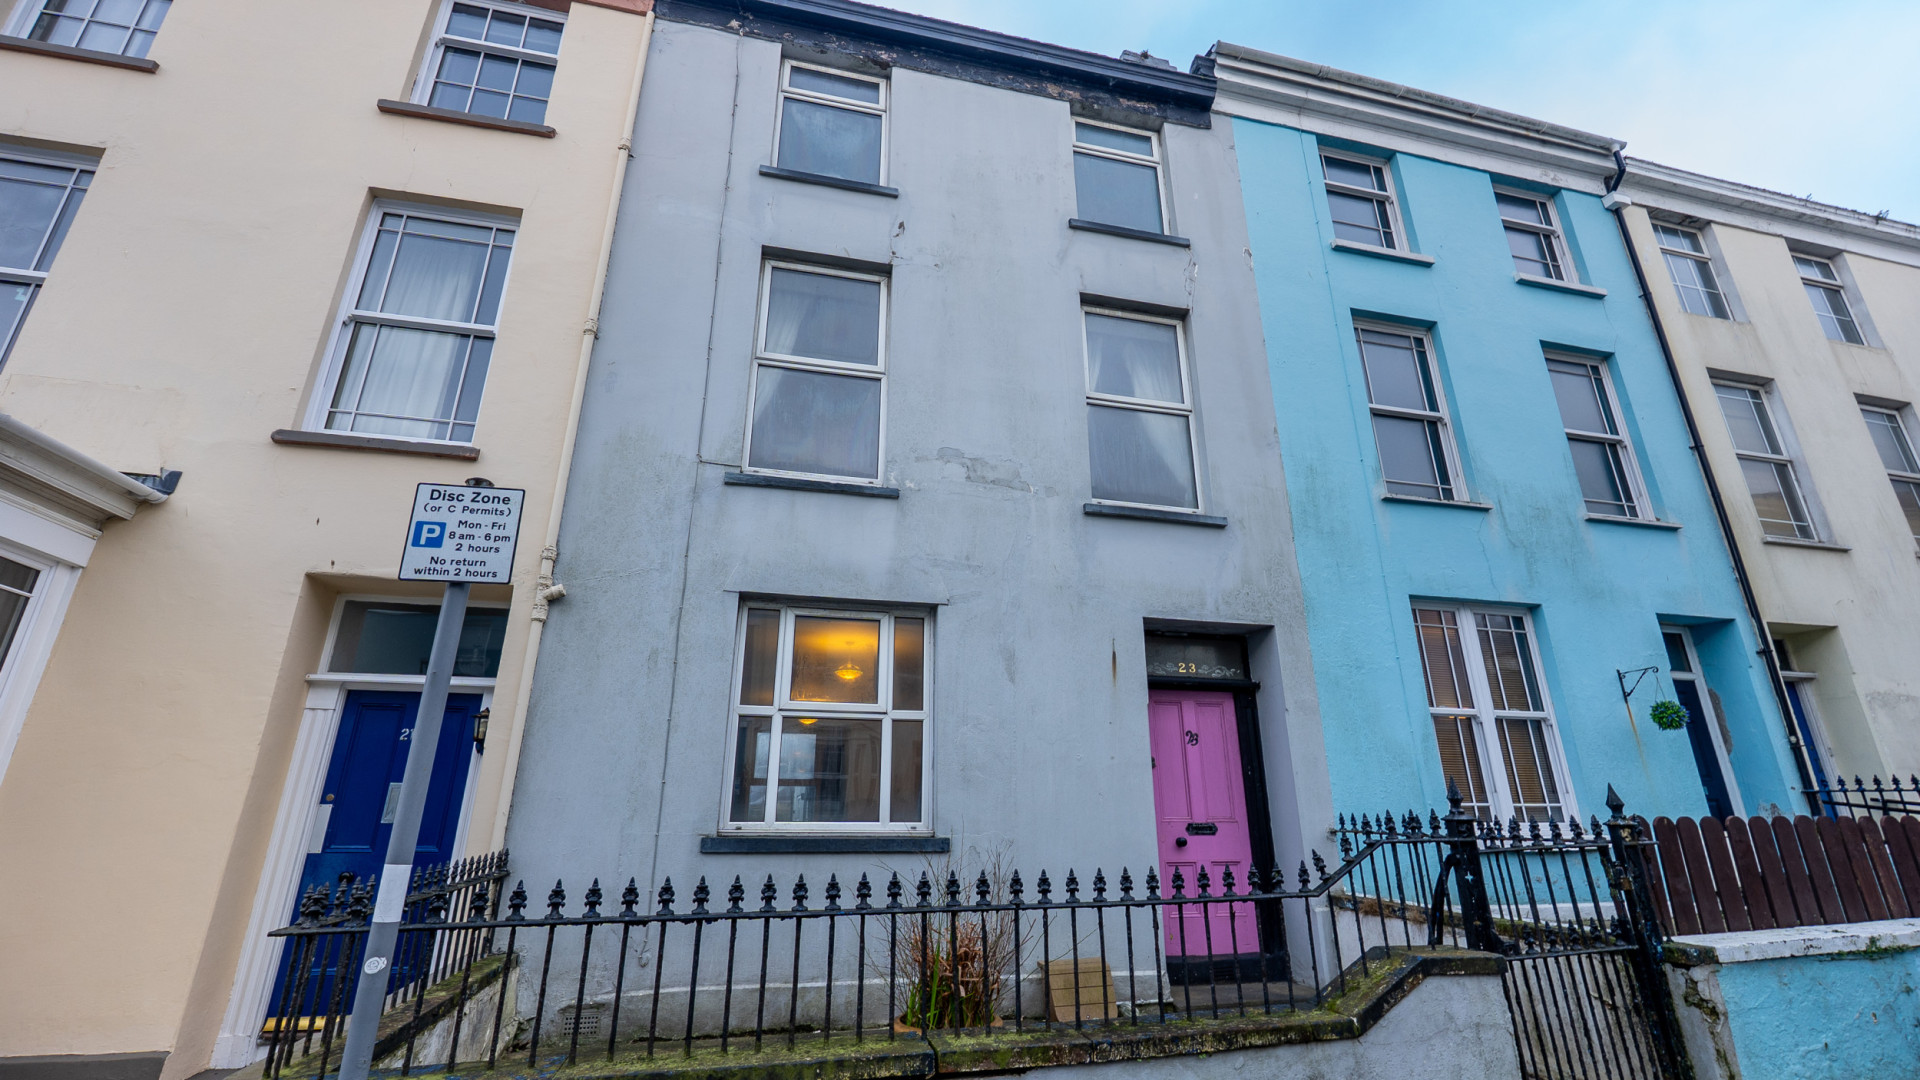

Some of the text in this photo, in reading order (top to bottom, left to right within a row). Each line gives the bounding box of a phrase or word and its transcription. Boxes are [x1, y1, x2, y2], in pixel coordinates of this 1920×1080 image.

[429, 488, 511, 505] Disc Zone
[423, 502, 512, 517] (or C Permits)
[457, 519, 482, 529] Mon
[491, 521, 507, 531] Fri
[419, 524, 441, 545] P
[455, 542, 500, 554] 2 hours
[429, 556, 487, 567] No return
[413, 566, 498, 578] within 2 hours
[1178, 662, 1196, 673] 23
[1185, 729, 1199, 746] 23
